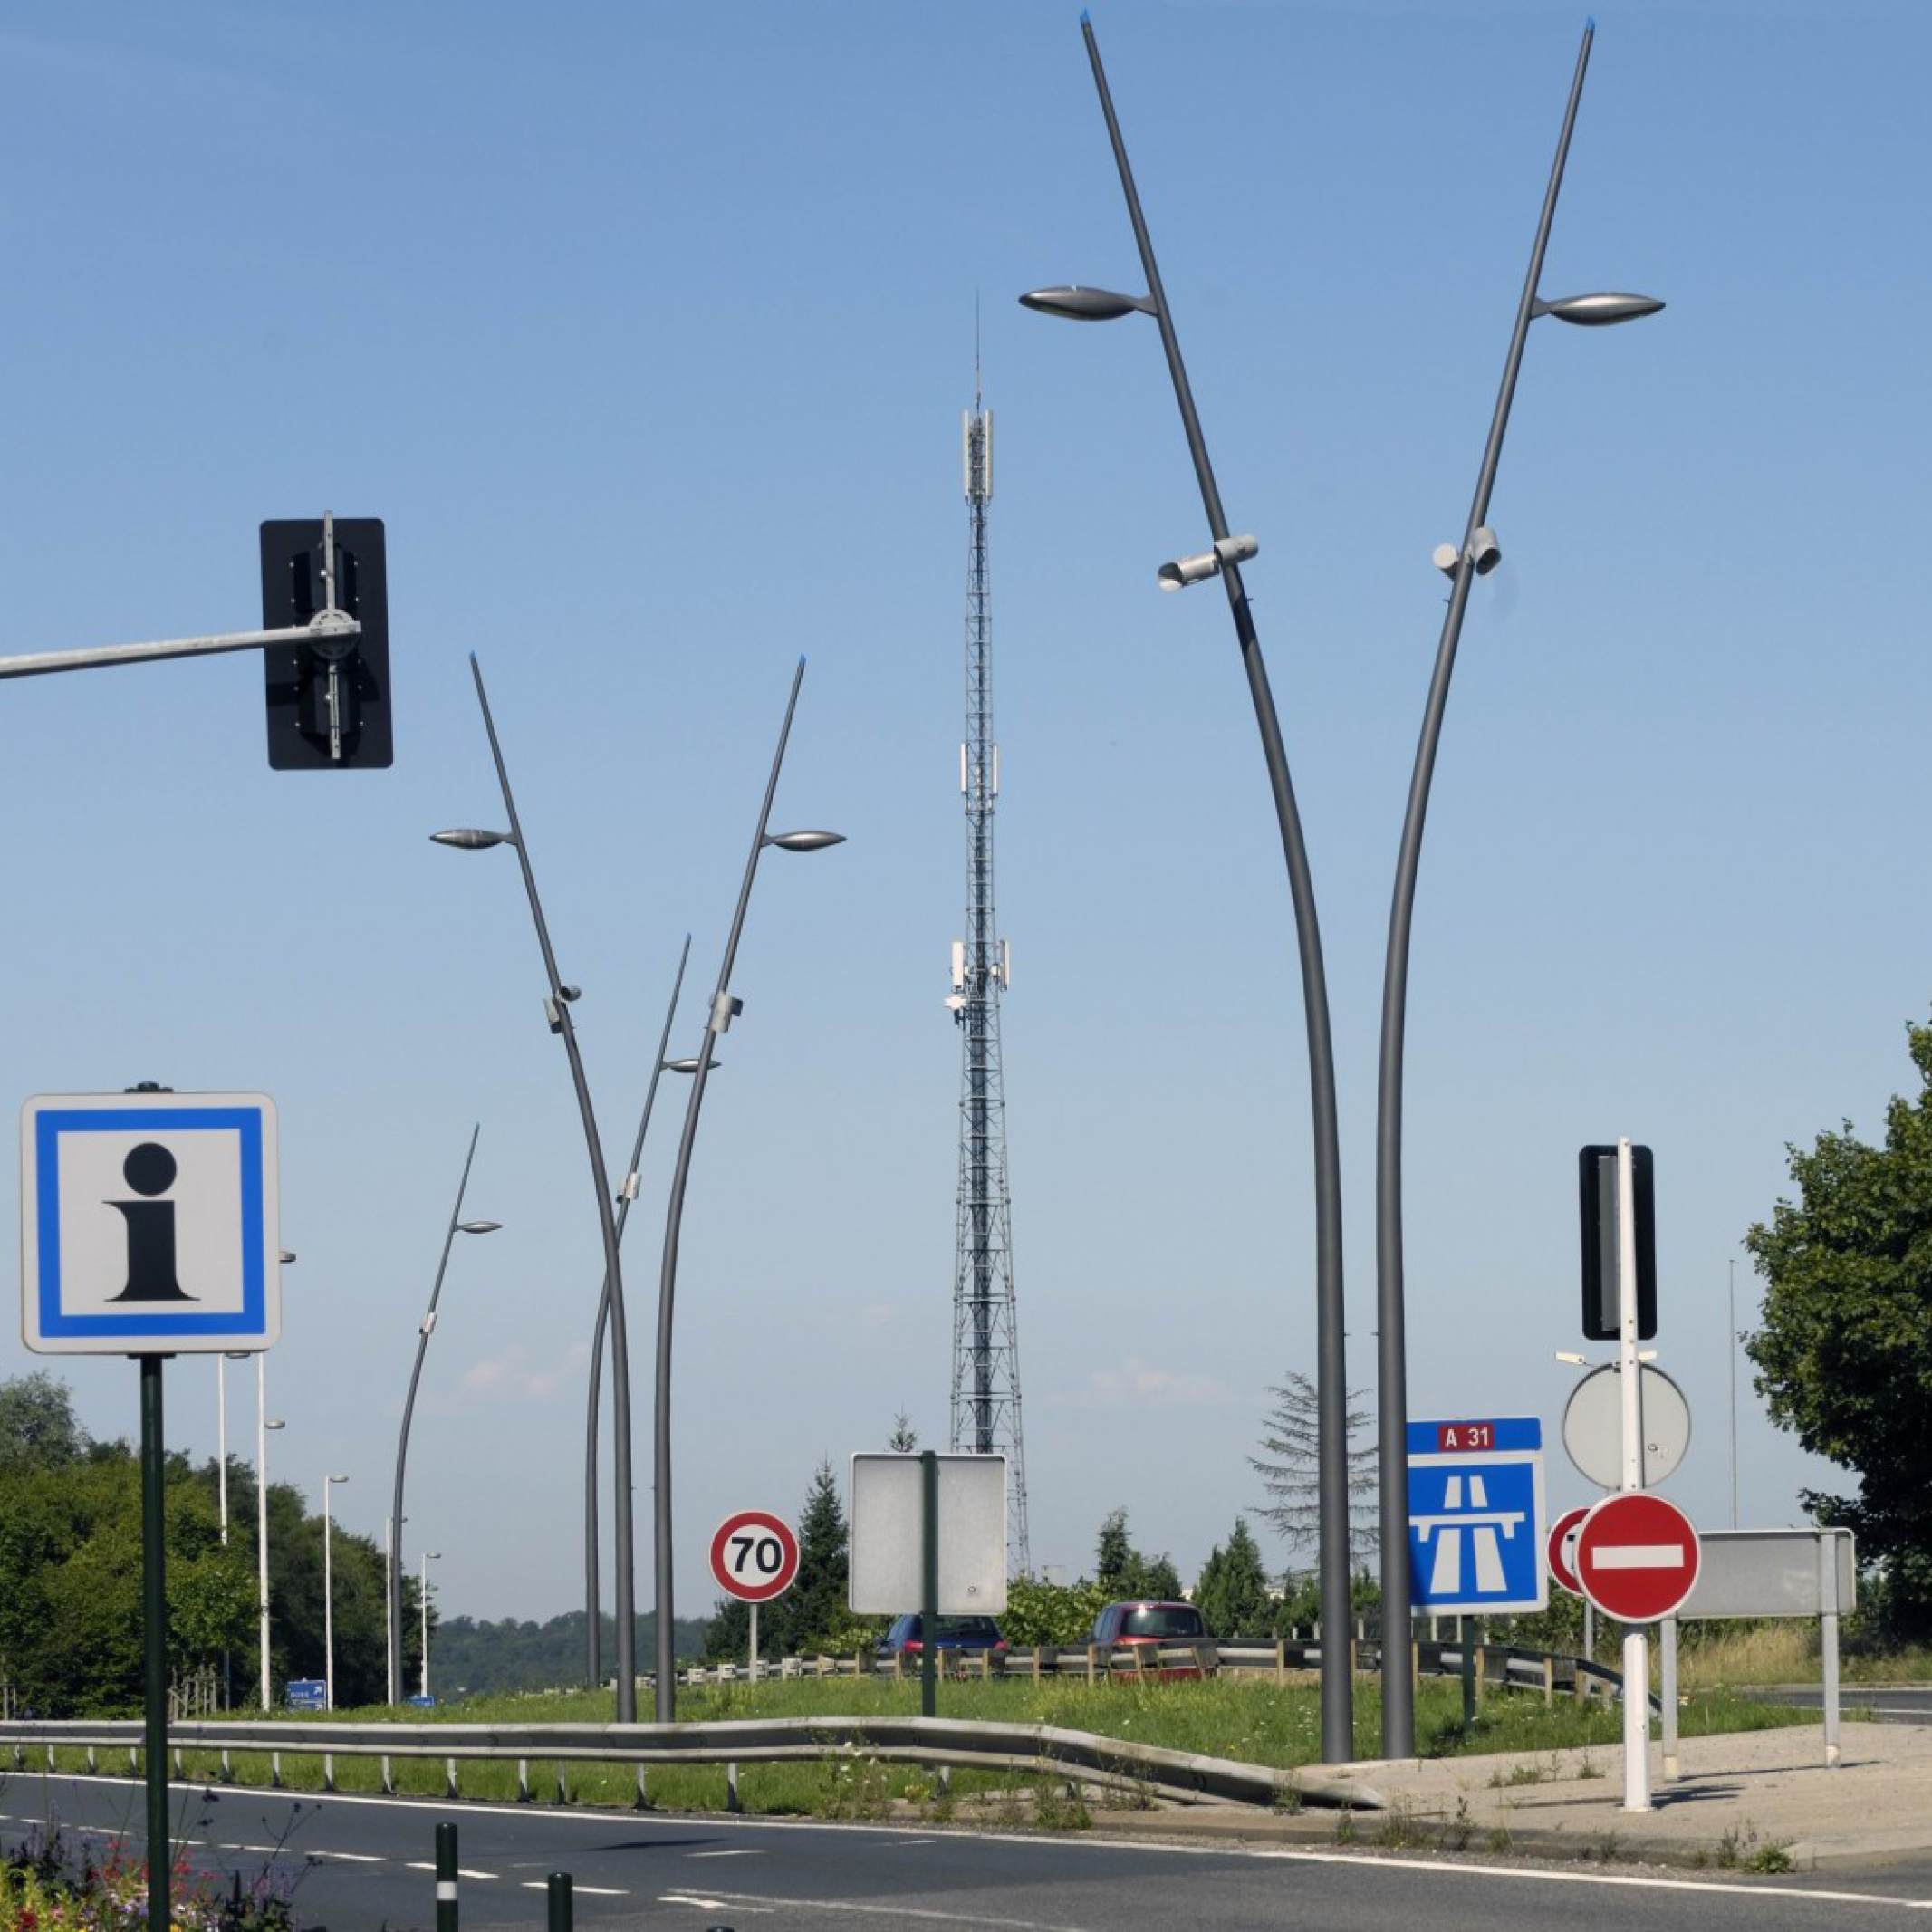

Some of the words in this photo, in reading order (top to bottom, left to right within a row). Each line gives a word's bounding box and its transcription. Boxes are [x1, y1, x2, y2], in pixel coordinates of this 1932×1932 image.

[1445, 1428, 1457, 1447] A
[1467, 1427, 1488, 1447] 31
[731, 1537, 782, 1573] 70
